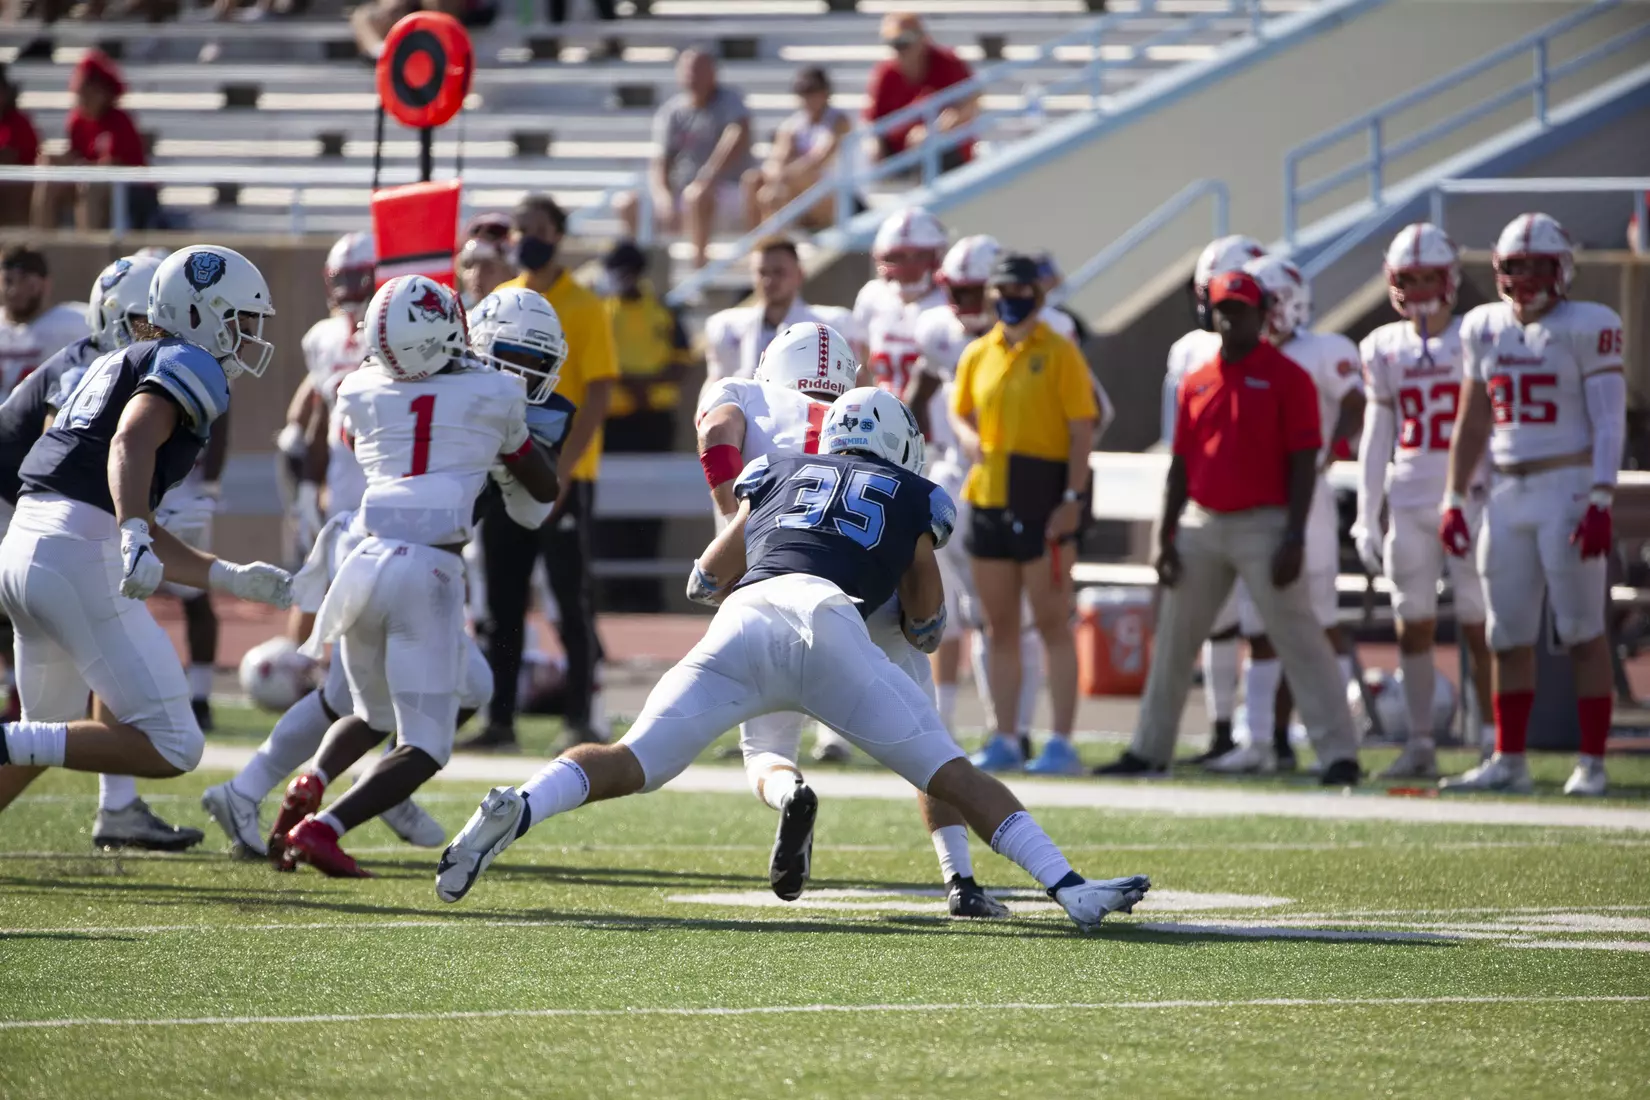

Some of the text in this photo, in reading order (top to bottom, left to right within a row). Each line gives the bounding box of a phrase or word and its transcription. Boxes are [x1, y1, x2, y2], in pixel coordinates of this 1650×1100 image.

[798, 379, 845, 395] Riddell
[1400, 382, 1461, 450] 82
[1488, 374, 1557, 424] 85
[402, 395, 437, 478] 1
[775, 463, 901, 551] 35
